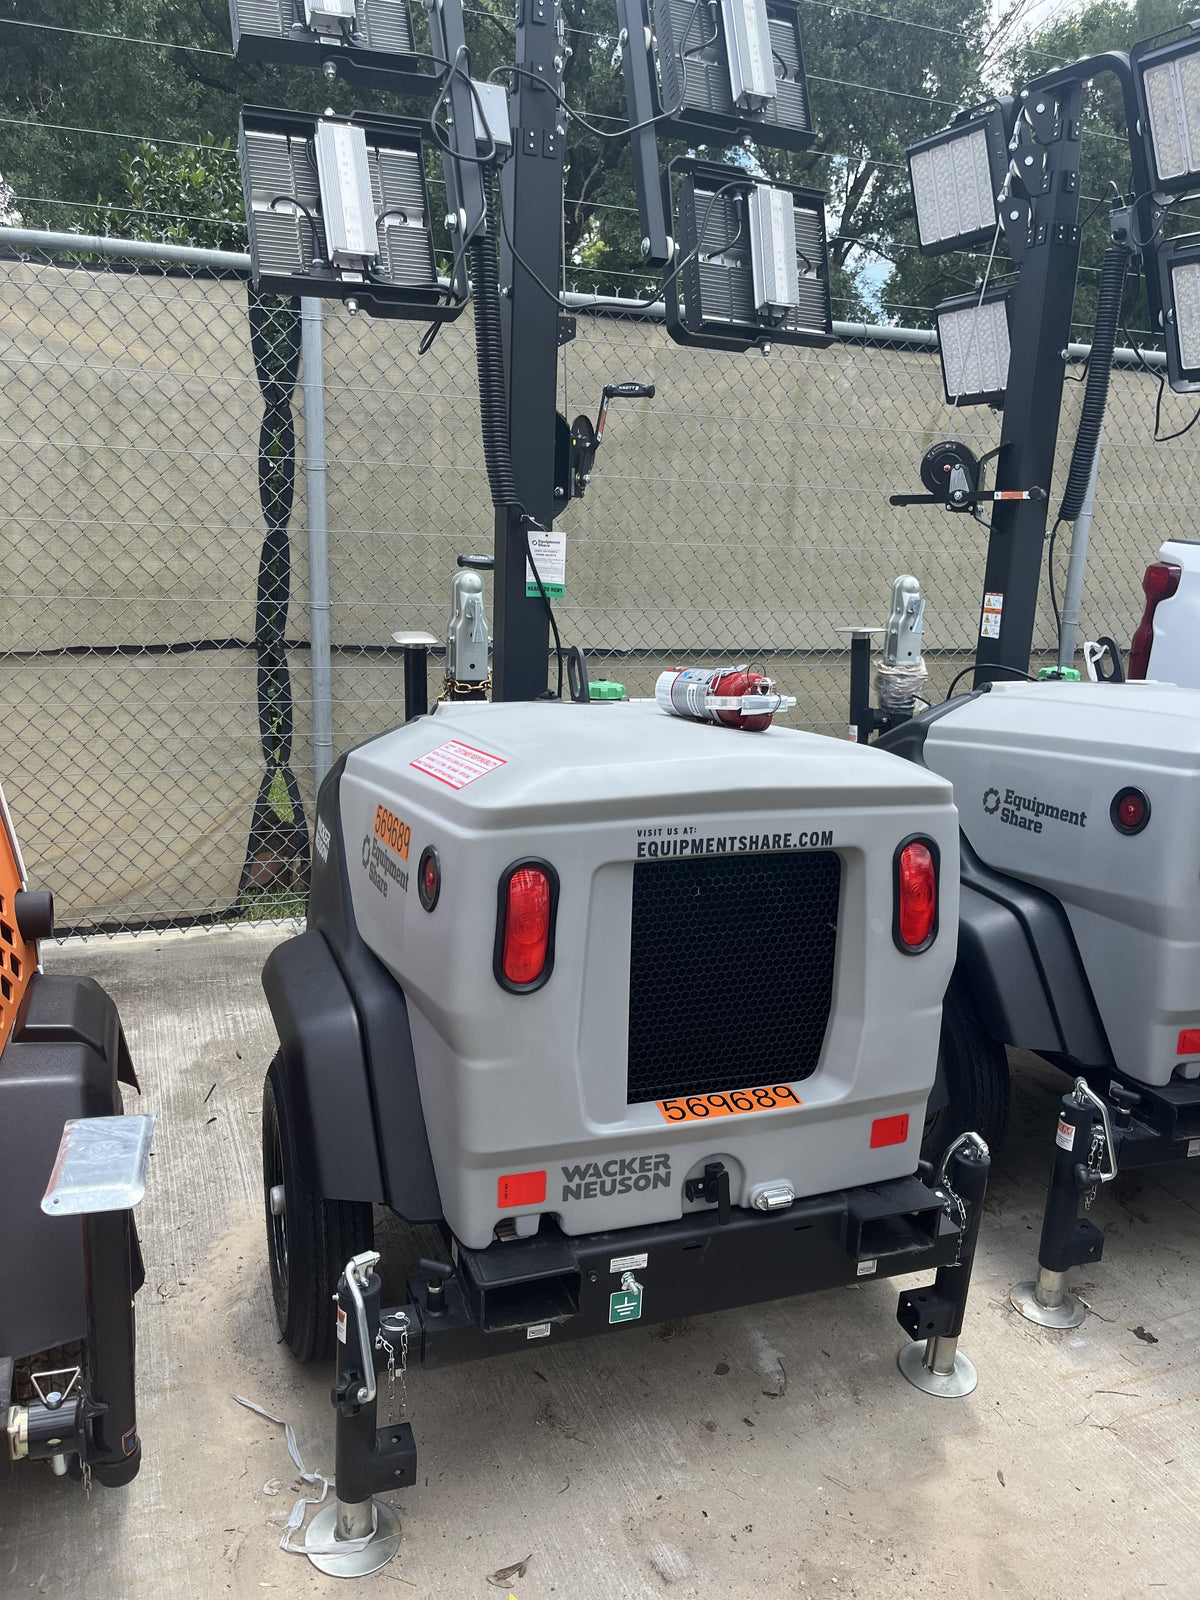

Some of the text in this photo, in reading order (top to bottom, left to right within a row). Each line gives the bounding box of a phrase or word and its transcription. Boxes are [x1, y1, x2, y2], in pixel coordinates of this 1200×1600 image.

[1000, 807, 1043, 834] Share
[1004, 788, 1087, 828] Equipment
[374, 805, 411, 860] 569689
[637, 826, 697, 838] VISIT US AT:
[637, 830, 834, 858] EQUIPMENTSHARE.COM
[369, 861, 388, 898] Share
[371, 837, 409, 892] Equipment
[662, 1085, 801, 1121] 569689
[561, 1153, 671, 1183] WACKER
[562, 1171, 671, 1202] NEUSON
